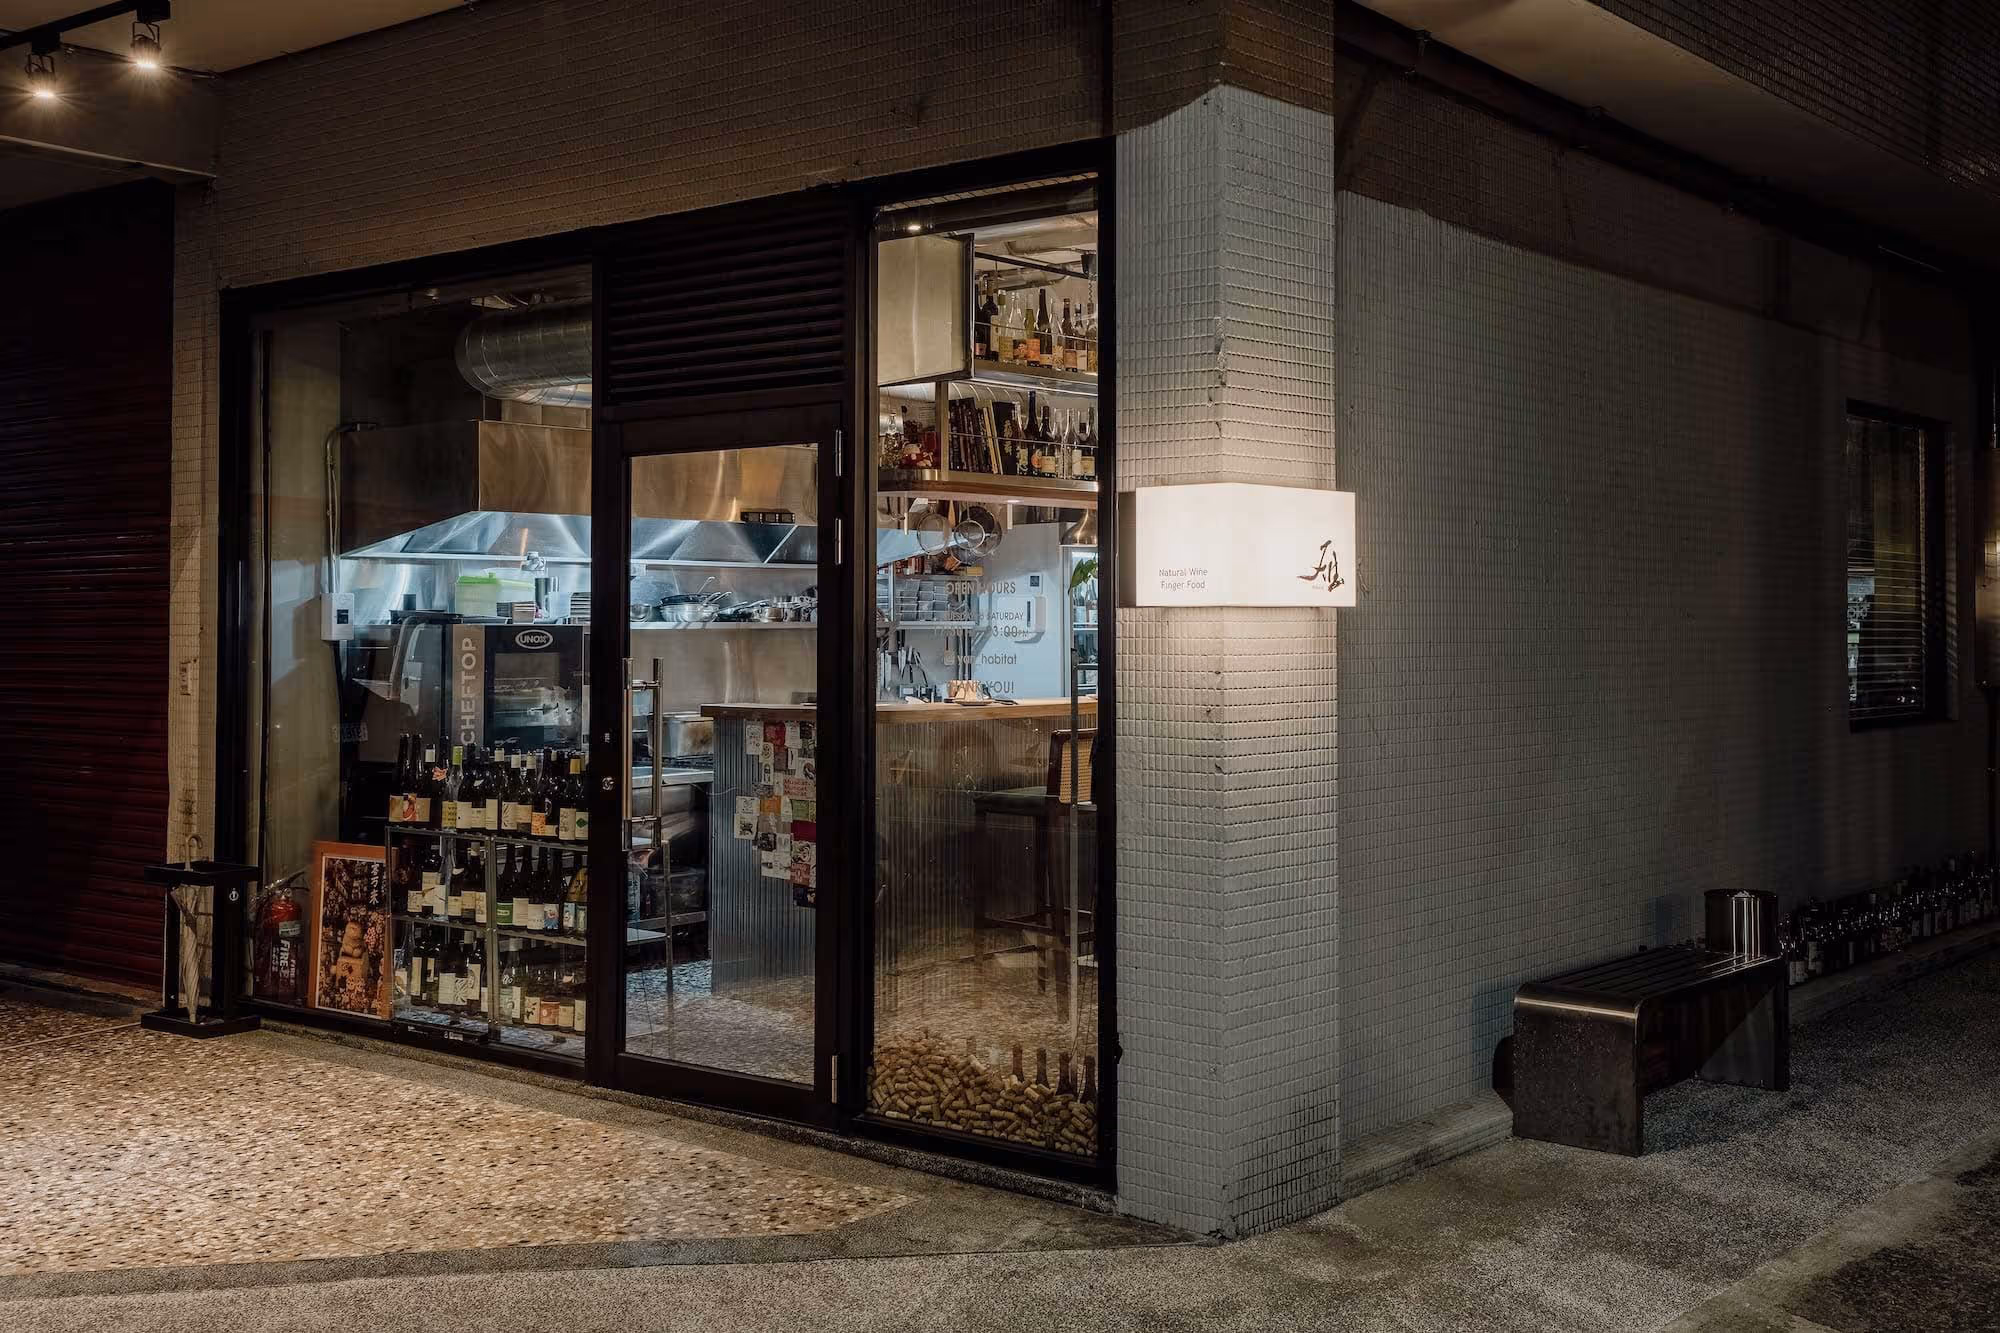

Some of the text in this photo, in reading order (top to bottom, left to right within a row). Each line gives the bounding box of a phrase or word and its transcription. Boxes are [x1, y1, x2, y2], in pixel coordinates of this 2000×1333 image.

[1158, 567, 1208, 577] Natural Wine
[1160, 580, 1206, 591] Finger Food
[519, 634, 548, 644] UNOX
[460, 637, 477, 746] CHEFTOP
[986, 680, 1015, 694] YOU!
